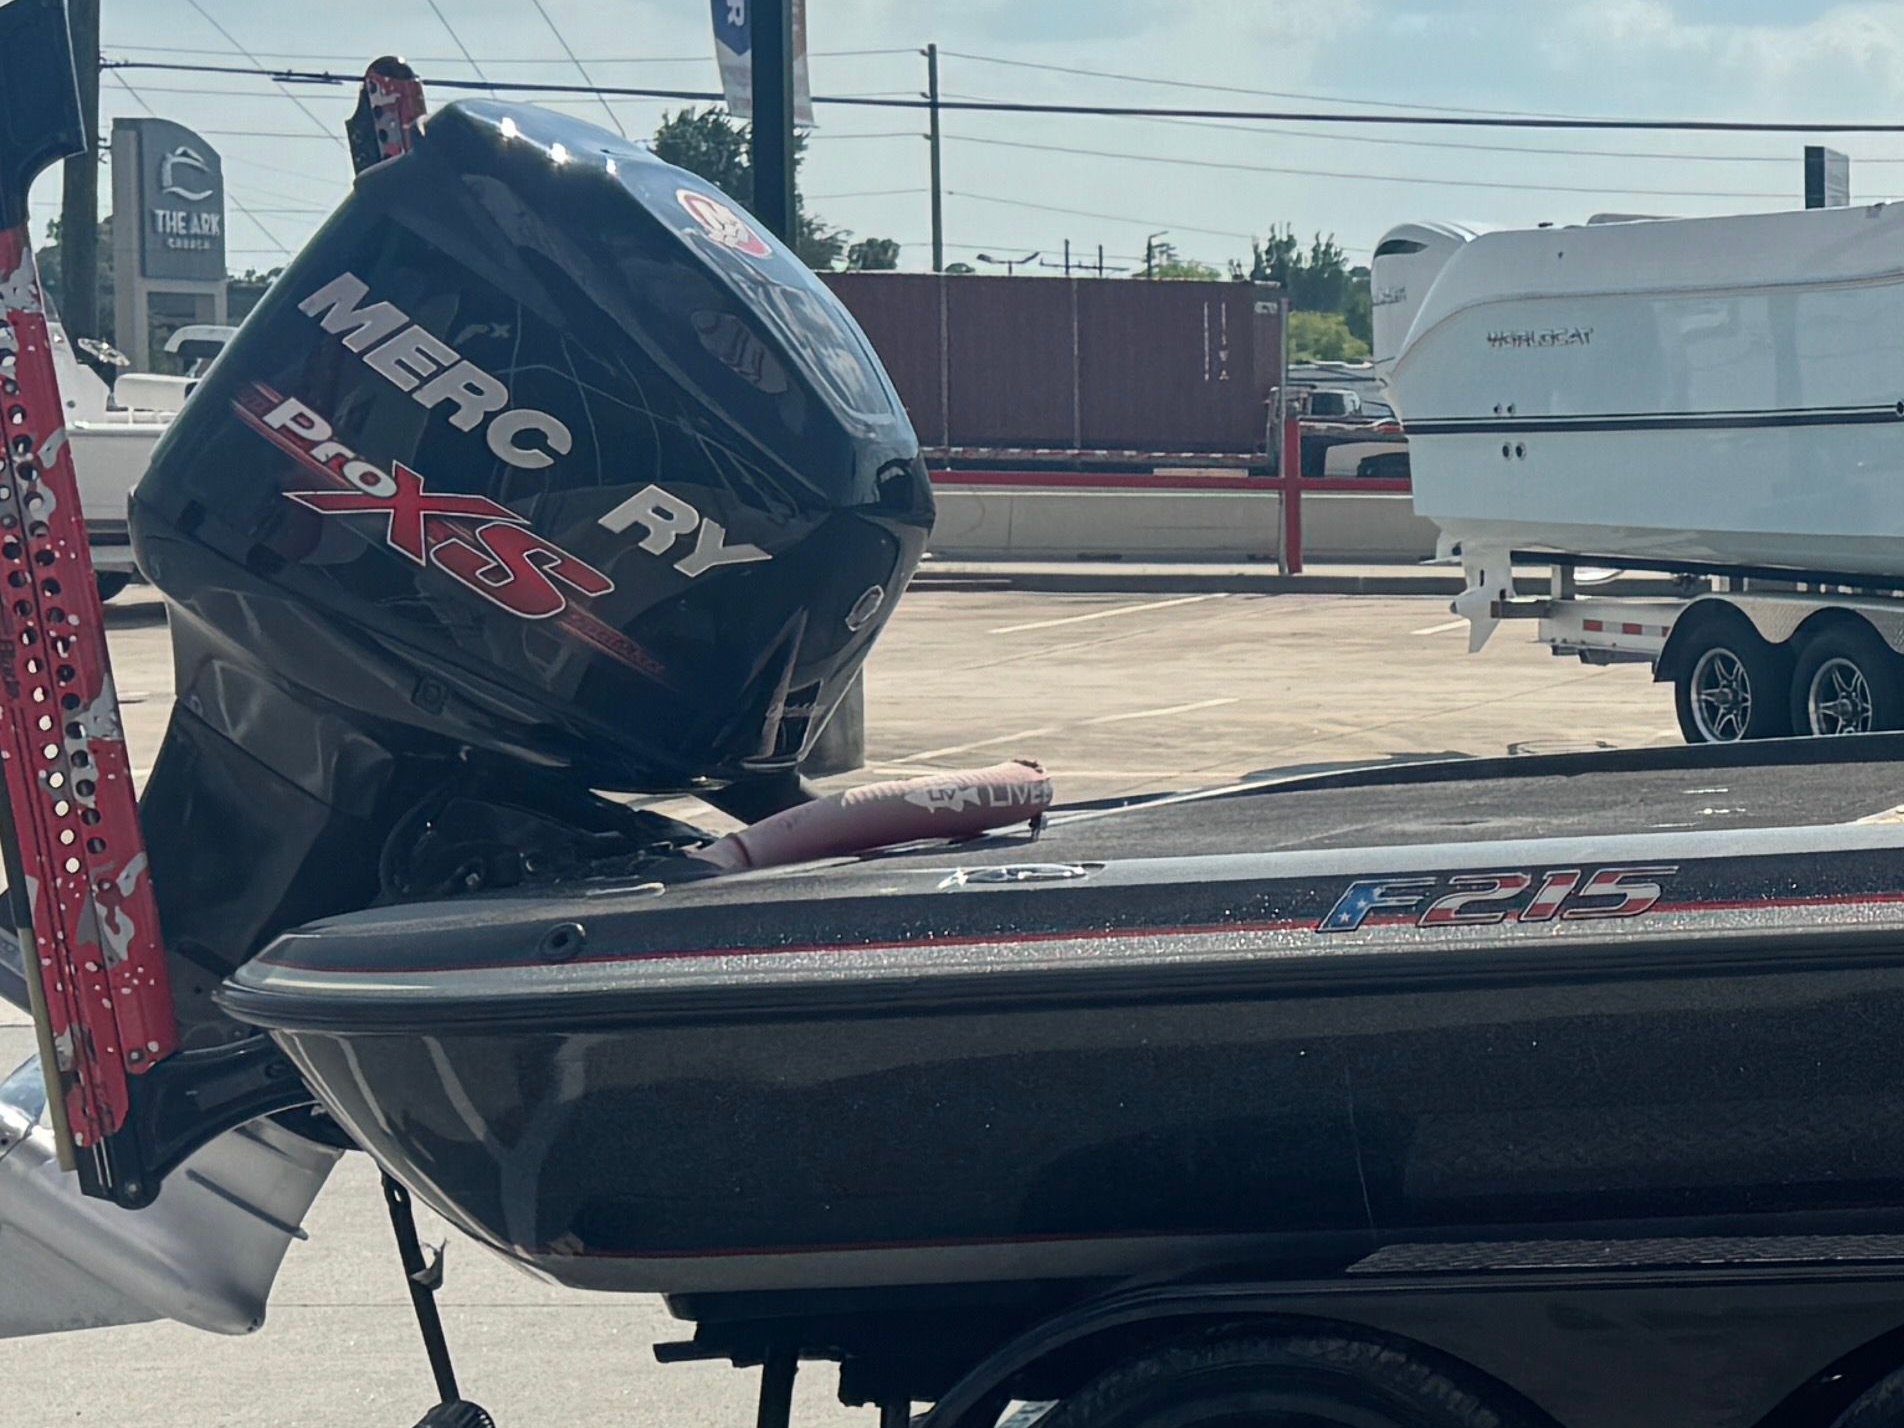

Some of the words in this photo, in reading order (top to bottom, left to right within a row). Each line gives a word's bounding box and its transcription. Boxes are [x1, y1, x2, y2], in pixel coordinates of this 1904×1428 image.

[154, 209, 187, 235] THE
[190, 212, 220, 236] ARK
[1315, 865, 1680, 934] F215
